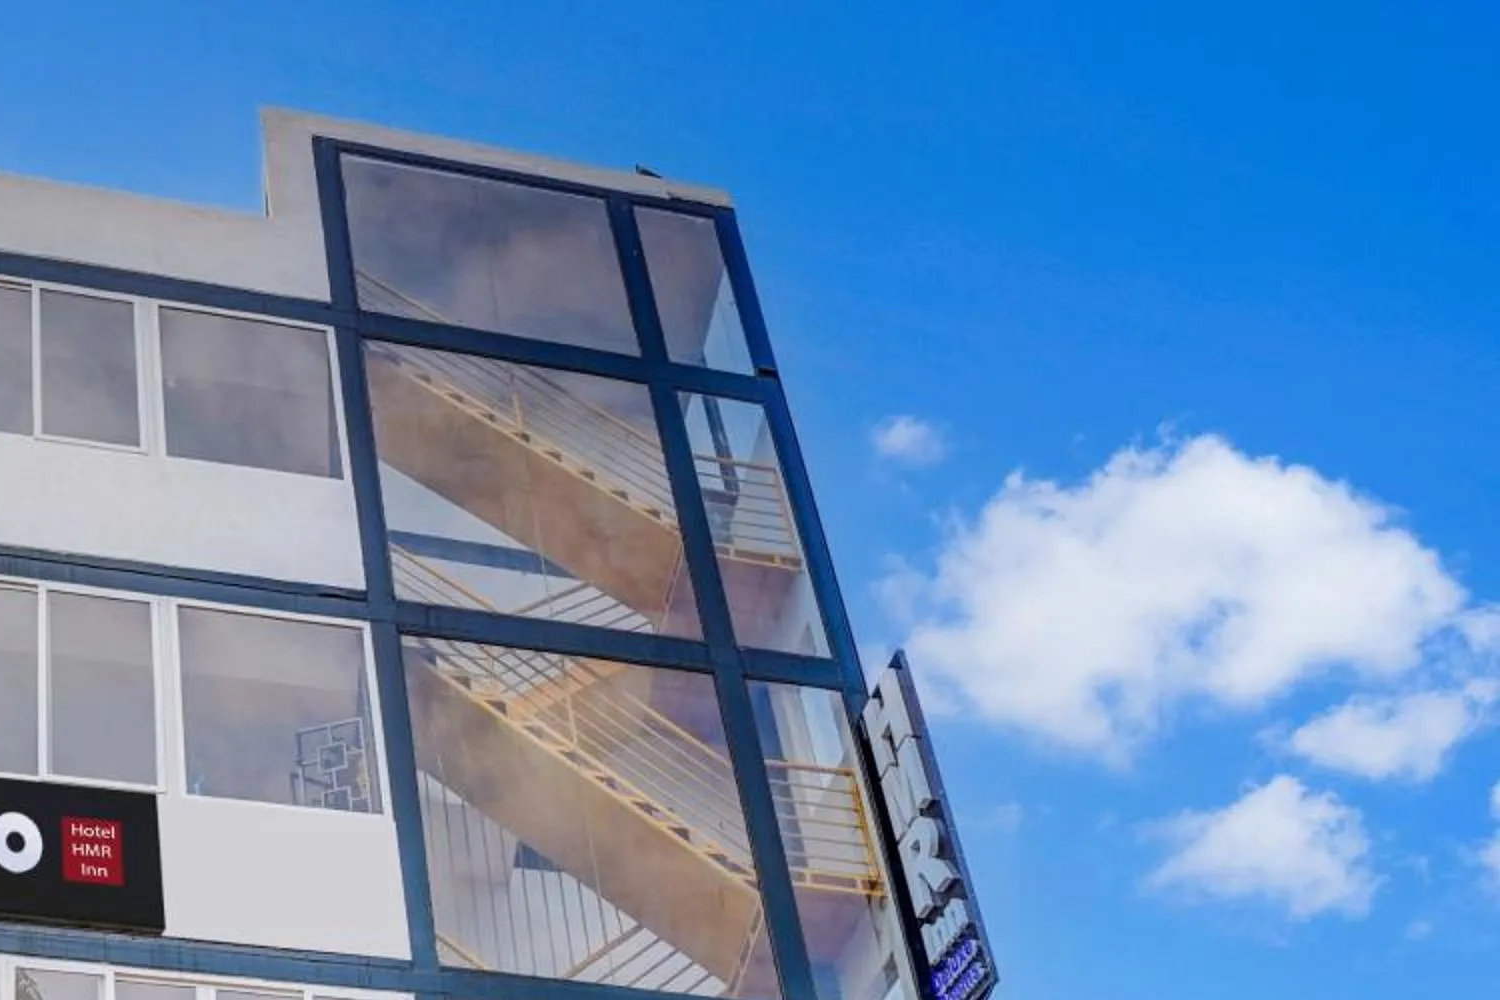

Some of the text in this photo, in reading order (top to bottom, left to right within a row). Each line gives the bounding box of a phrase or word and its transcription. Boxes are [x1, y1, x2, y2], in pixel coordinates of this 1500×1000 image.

[71, 823, 116, 840] Hotel
[71, 843, 112, 859] HMR
[80, 863, 109, 878] Inn
